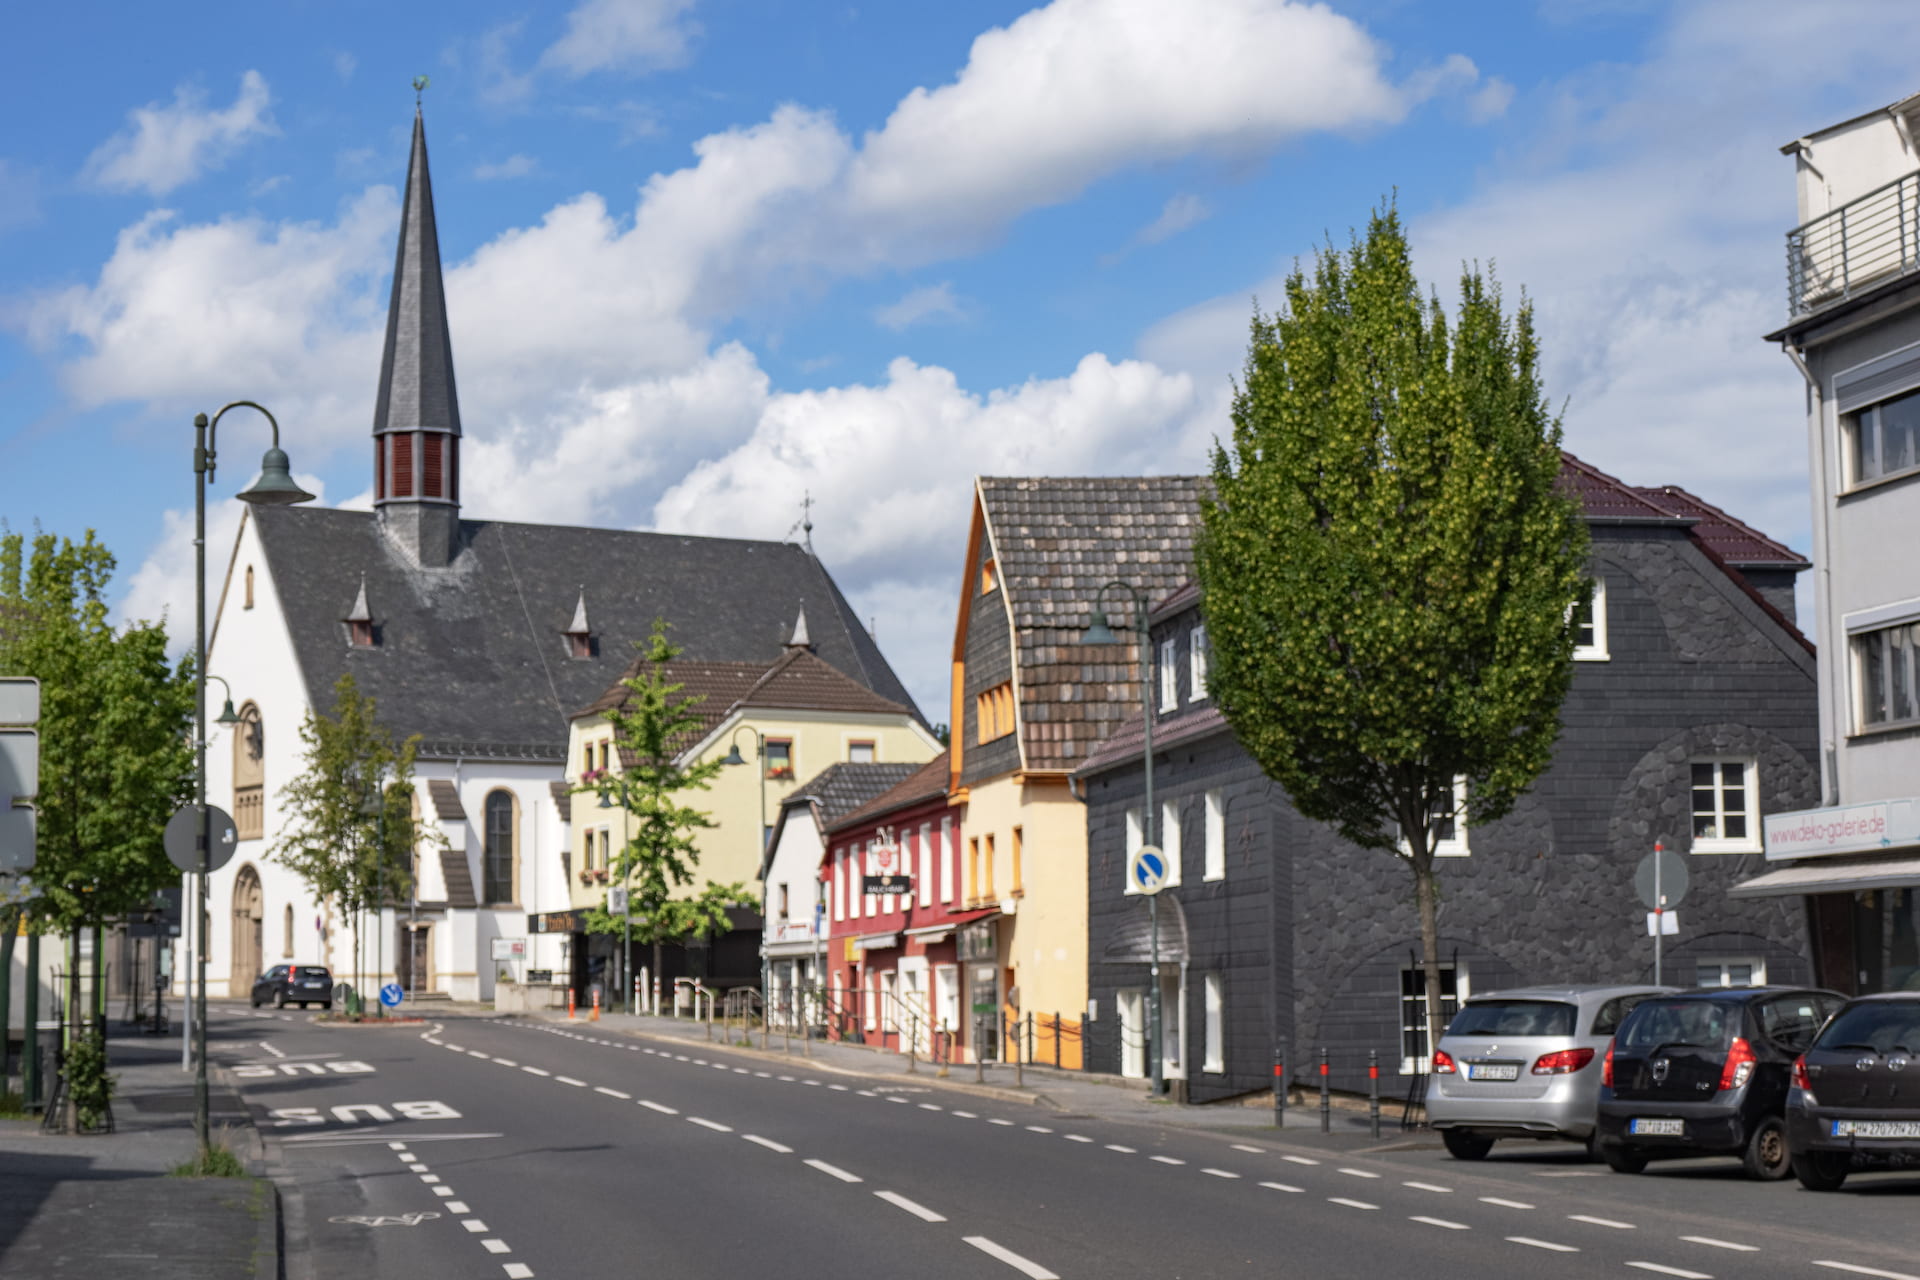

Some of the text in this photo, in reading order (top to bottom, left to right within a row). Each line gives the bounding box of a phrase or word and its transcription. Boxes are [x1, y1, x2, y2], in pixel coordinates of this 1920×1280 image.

[1770, 808, 1885, 844] www.deko-galerie.de
[231, 1060, 376, 1077] BUS
[267, 1101, 462, 1127] BUS
